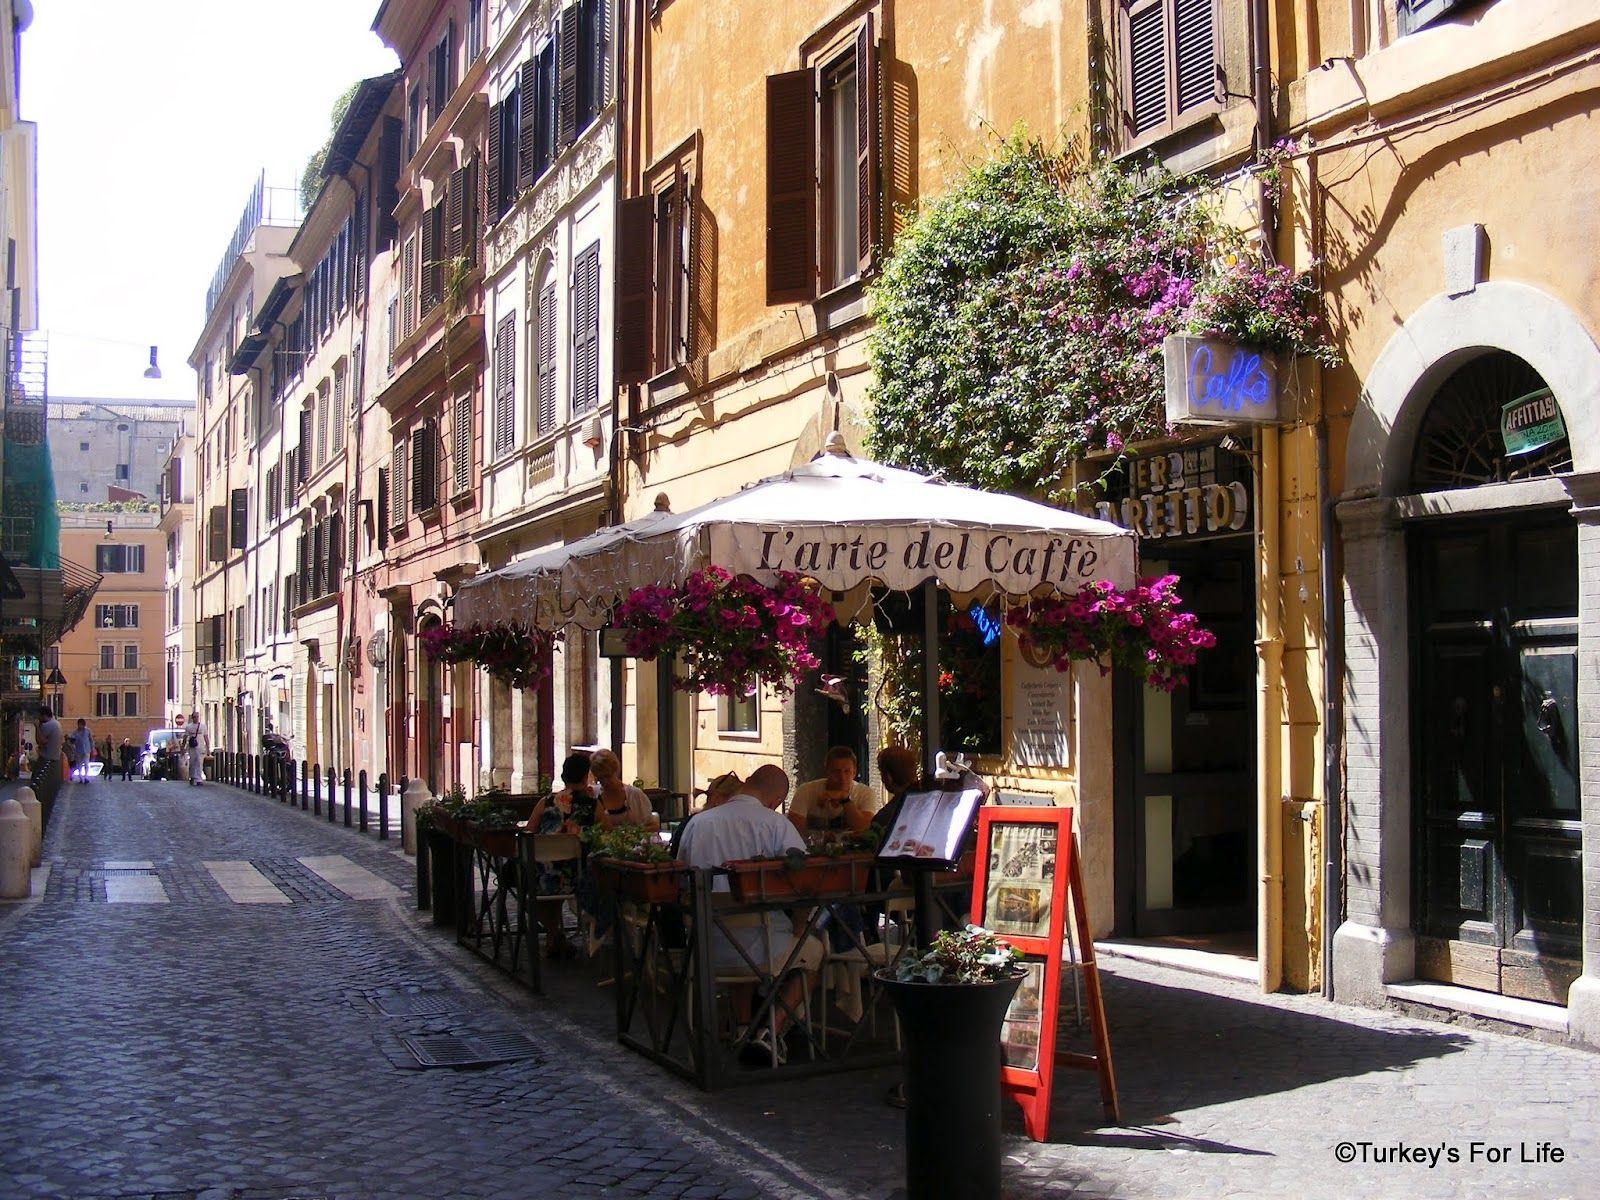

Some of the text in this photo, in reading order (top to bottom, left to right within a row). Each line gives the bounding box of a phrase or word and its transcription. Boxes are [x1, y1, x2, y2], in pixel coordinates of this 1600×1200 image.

[1505, 396, 1557, 432] AFFITTASI
[756, 530, 1098, 582] L'arte del Caffè
